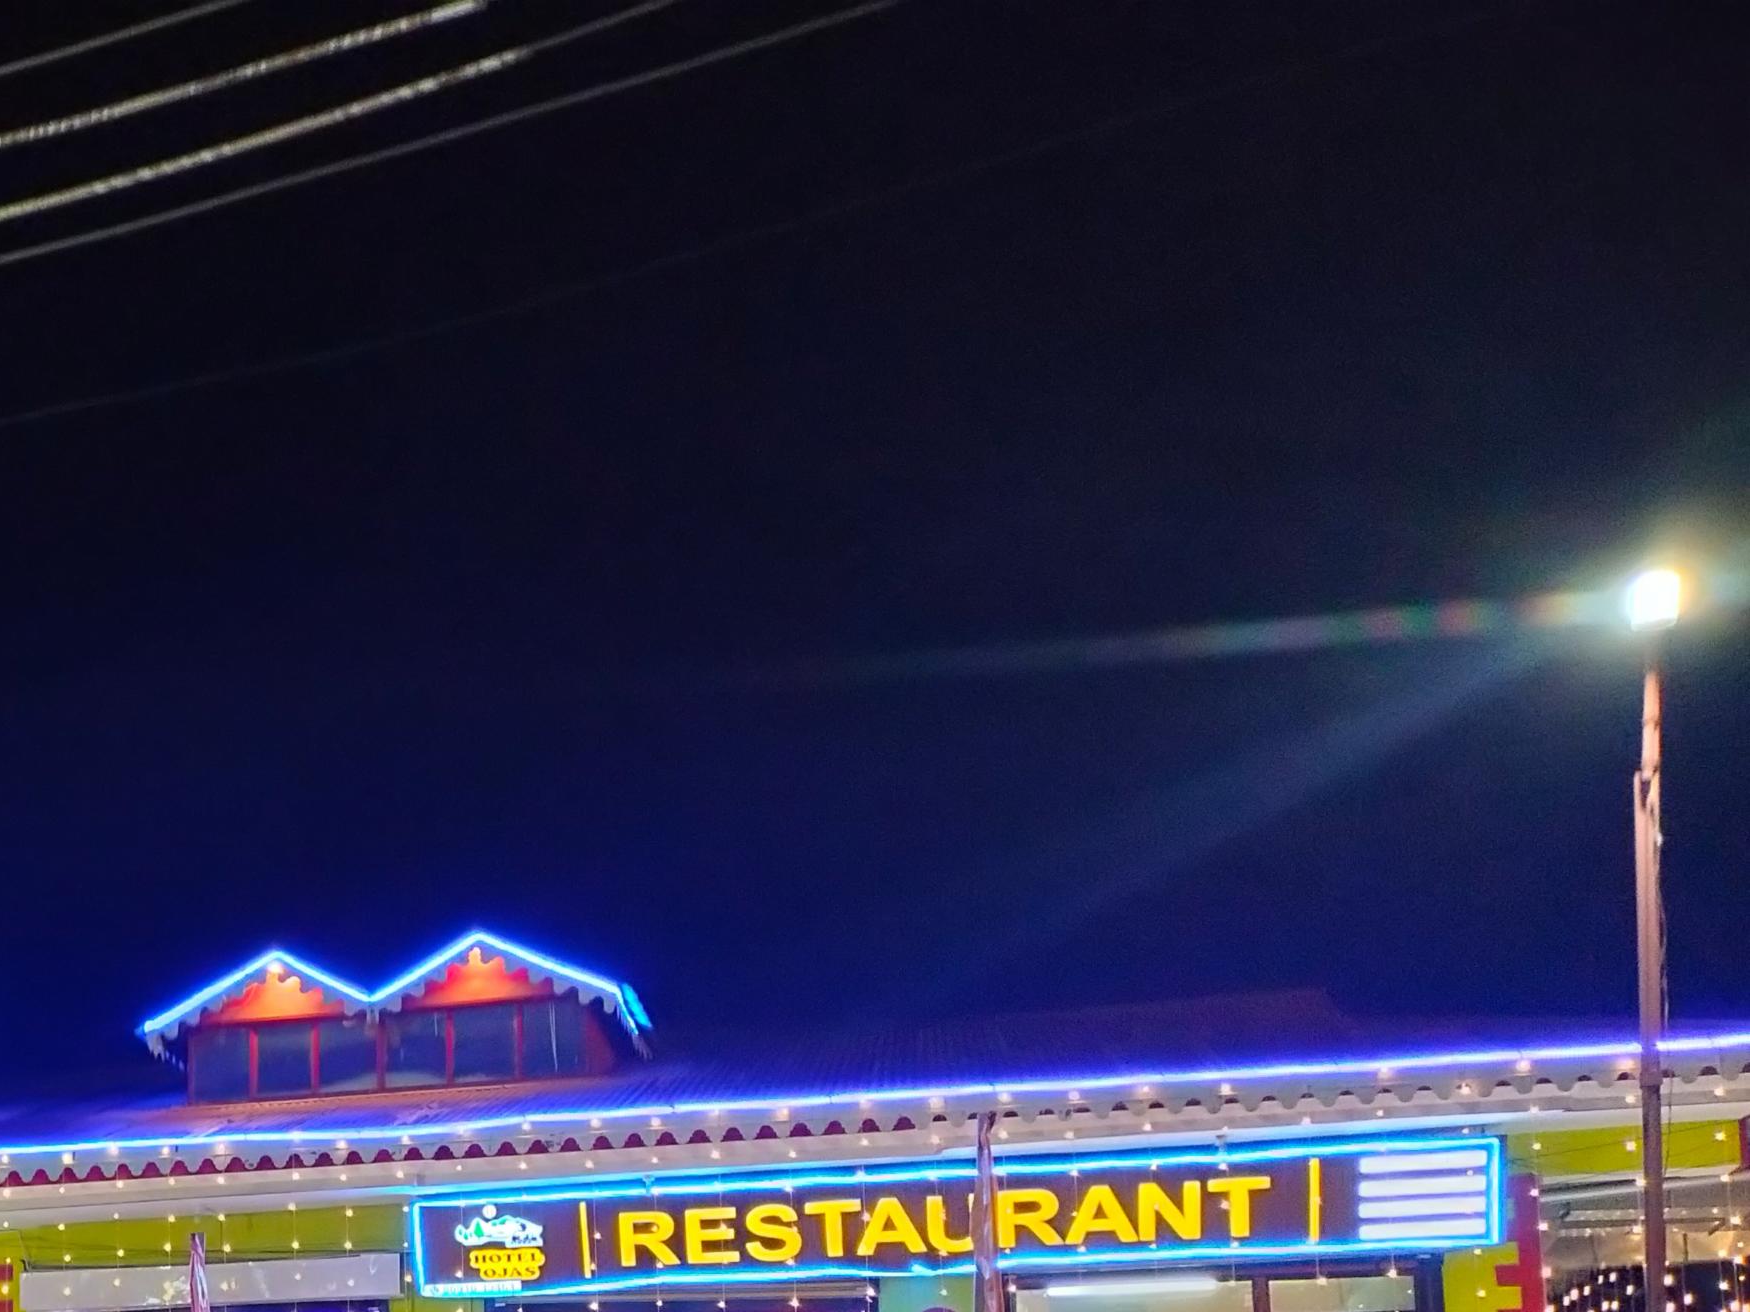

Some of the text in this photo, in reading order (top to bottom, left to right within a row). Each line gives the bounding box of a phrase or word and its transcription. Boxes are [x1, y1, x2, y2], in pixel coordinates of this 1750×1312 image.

[616, 1176, 1271, 1268] RESTAURANT
[474, 1252, 537, 1264] HOTEL
[483, 1266, 536, 1278] OJAS
